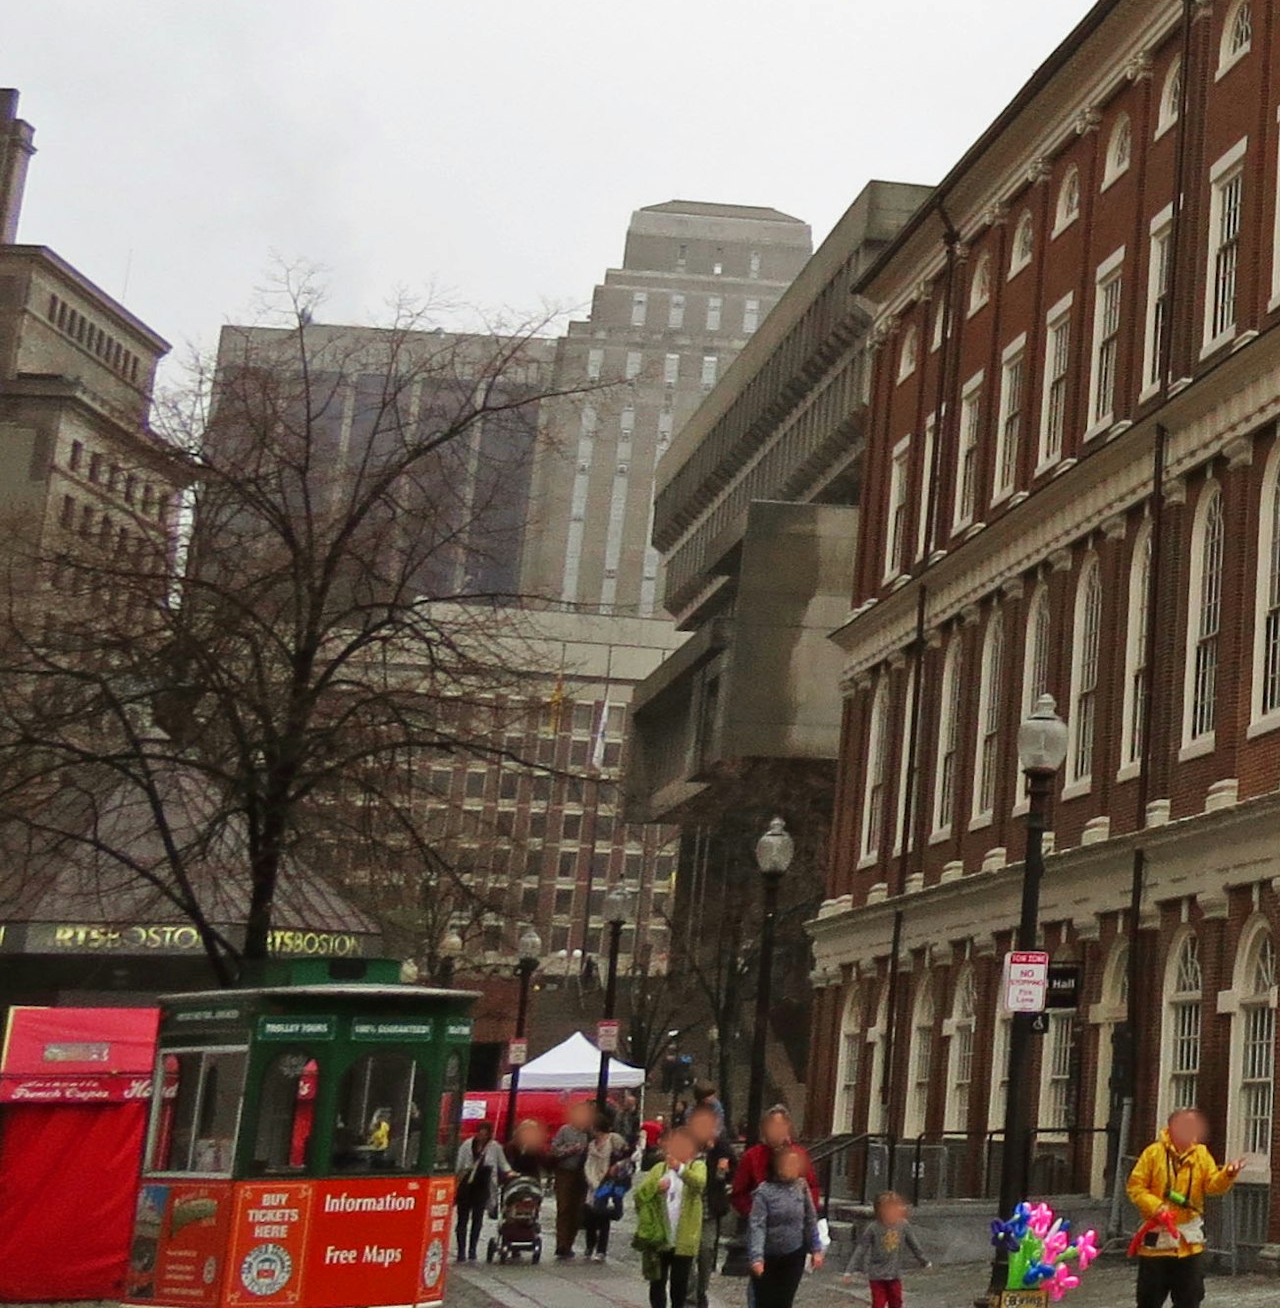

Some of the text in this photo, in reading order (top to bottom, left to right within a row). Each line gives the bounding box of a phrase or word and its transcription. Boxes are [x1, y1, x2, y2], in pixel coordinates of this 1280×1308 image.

[1020, 969, 1035, 978] NO
[1052, 978, 1075, 989] Hall
[262, 1193, 289, 1206] BUY
[324, 1192, 415, 1212] Information
[247, 1208, 299, 1222] TICKETS
[254, 1224, 288, 1238] HERE
[325, 1245, 357, 1265] Free
[362, 1244, 402, 1267] Maps
